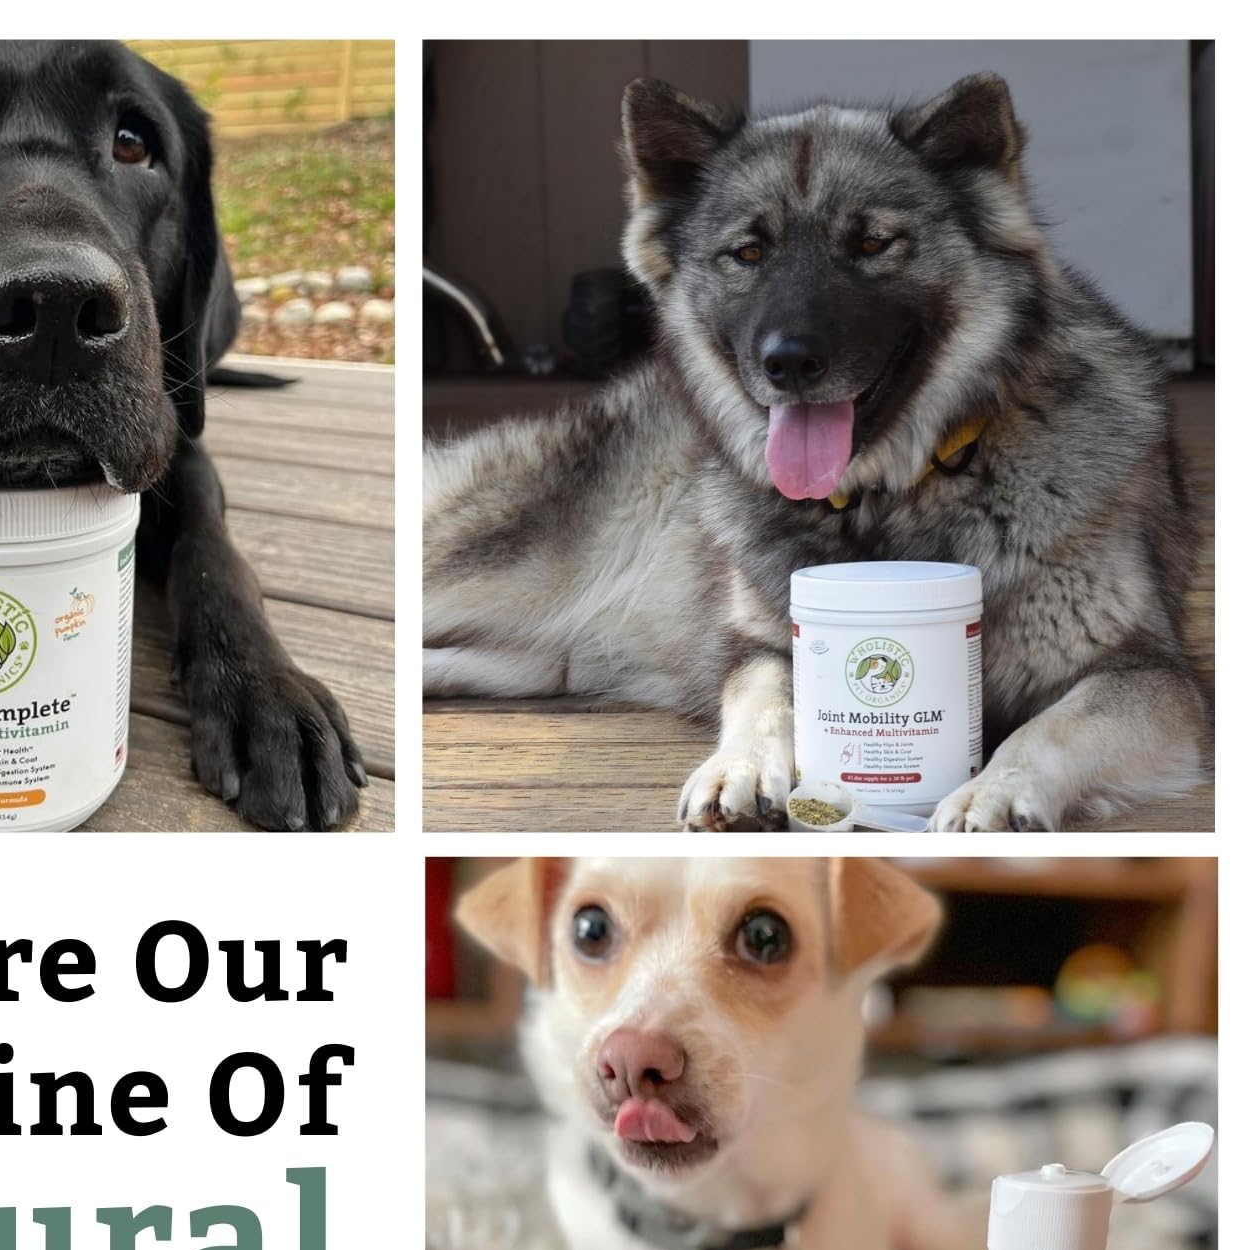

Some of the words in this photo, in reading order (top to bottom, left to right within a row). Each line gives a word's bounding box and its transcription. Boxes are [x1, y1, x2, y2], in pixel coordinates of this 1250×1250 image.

[55, 608, 84, 623] organic
[850, 641, 909, 666] WHOLISTIC
[818, 710, 844, 722] Joint
[849, 712, 909, 727] Mobility
[831, 727, 873, 736] Enhanced
[876, 728, 939, 736] Multivitamin
[31, 764, 55, 773] System
[25, 775, 49, 784] System
